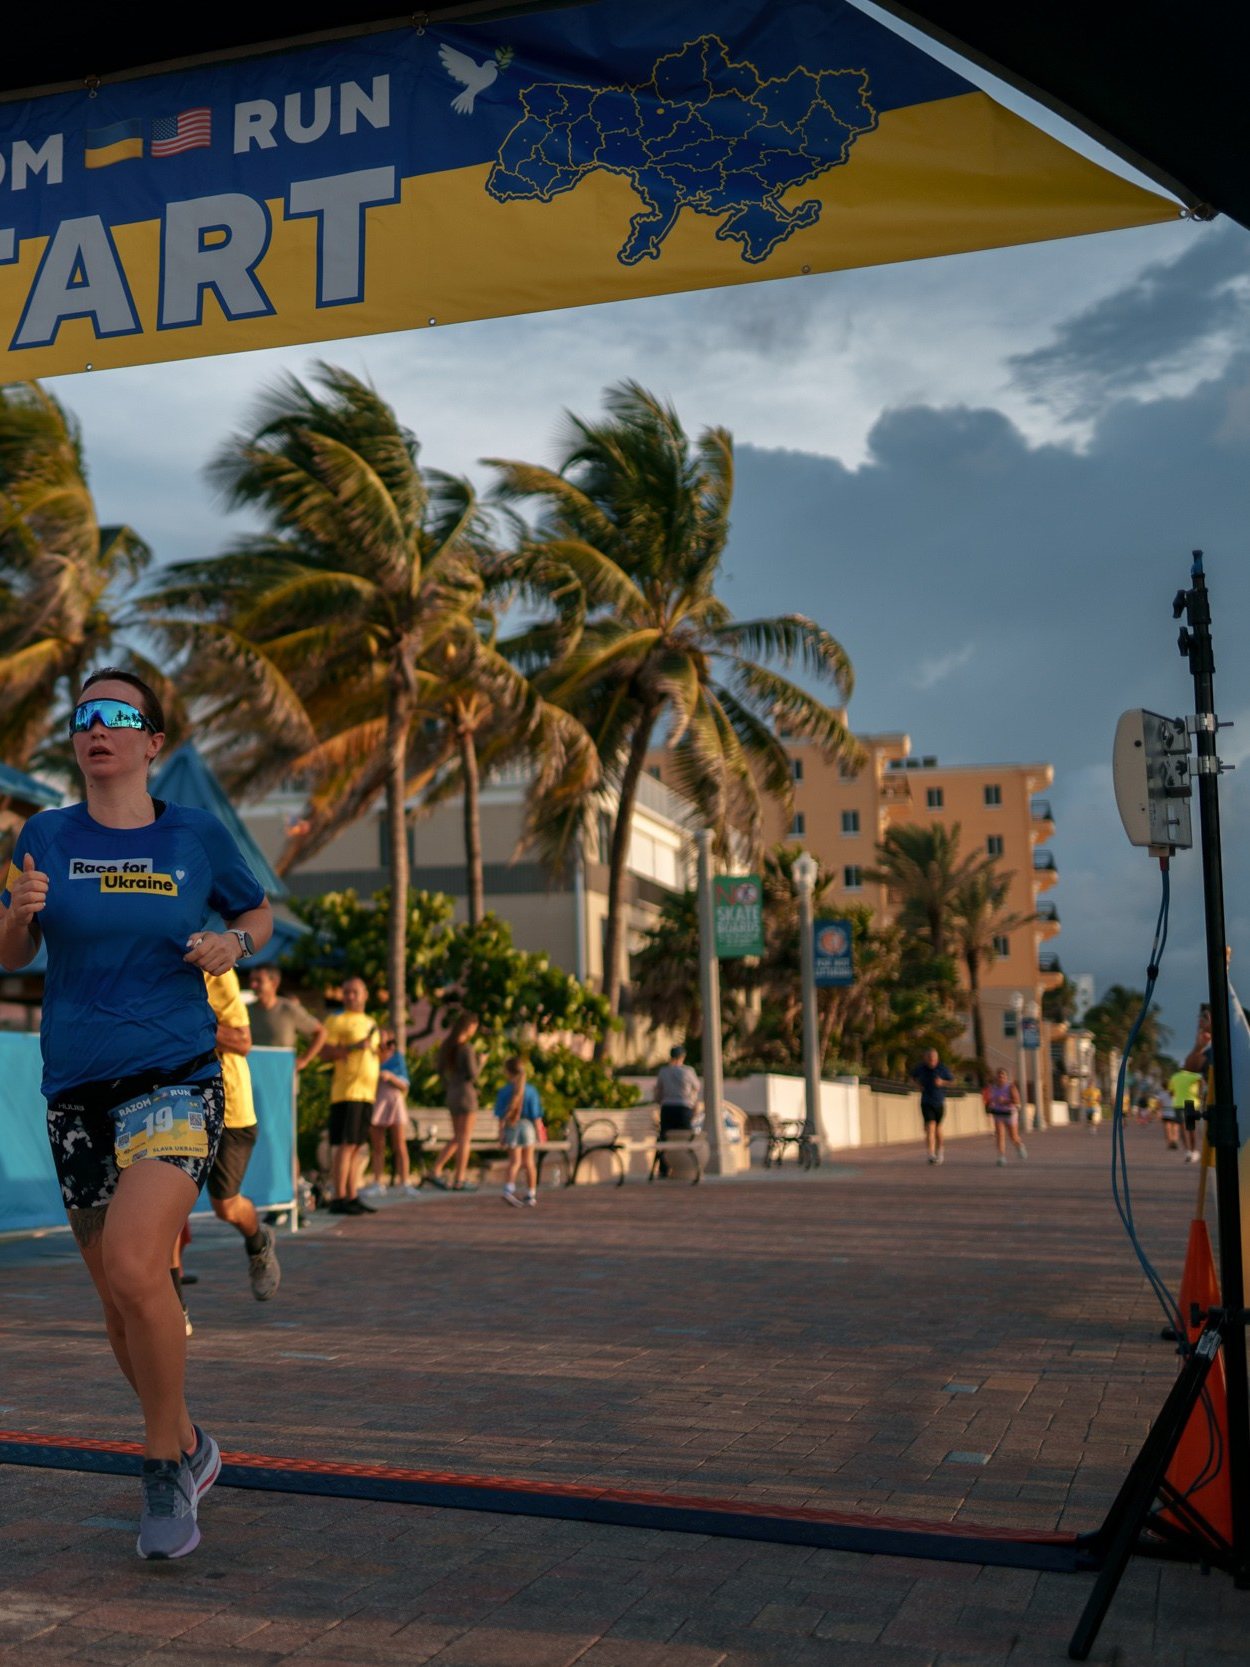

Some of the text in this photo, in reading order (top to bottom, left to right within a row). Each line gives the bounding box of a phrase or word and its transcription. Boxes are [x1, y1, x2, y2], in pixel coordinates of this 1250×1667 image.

[233, 74, 390, 154] RUN
[73, 861, 148, 874] Race for
[105, 876, 173, 891] Ukraine
[717, 905, 759, 920] SKATE
[118, 1089, 191, 1117] RAZOM RUN
[142, 1106, 174, 1139] 19
